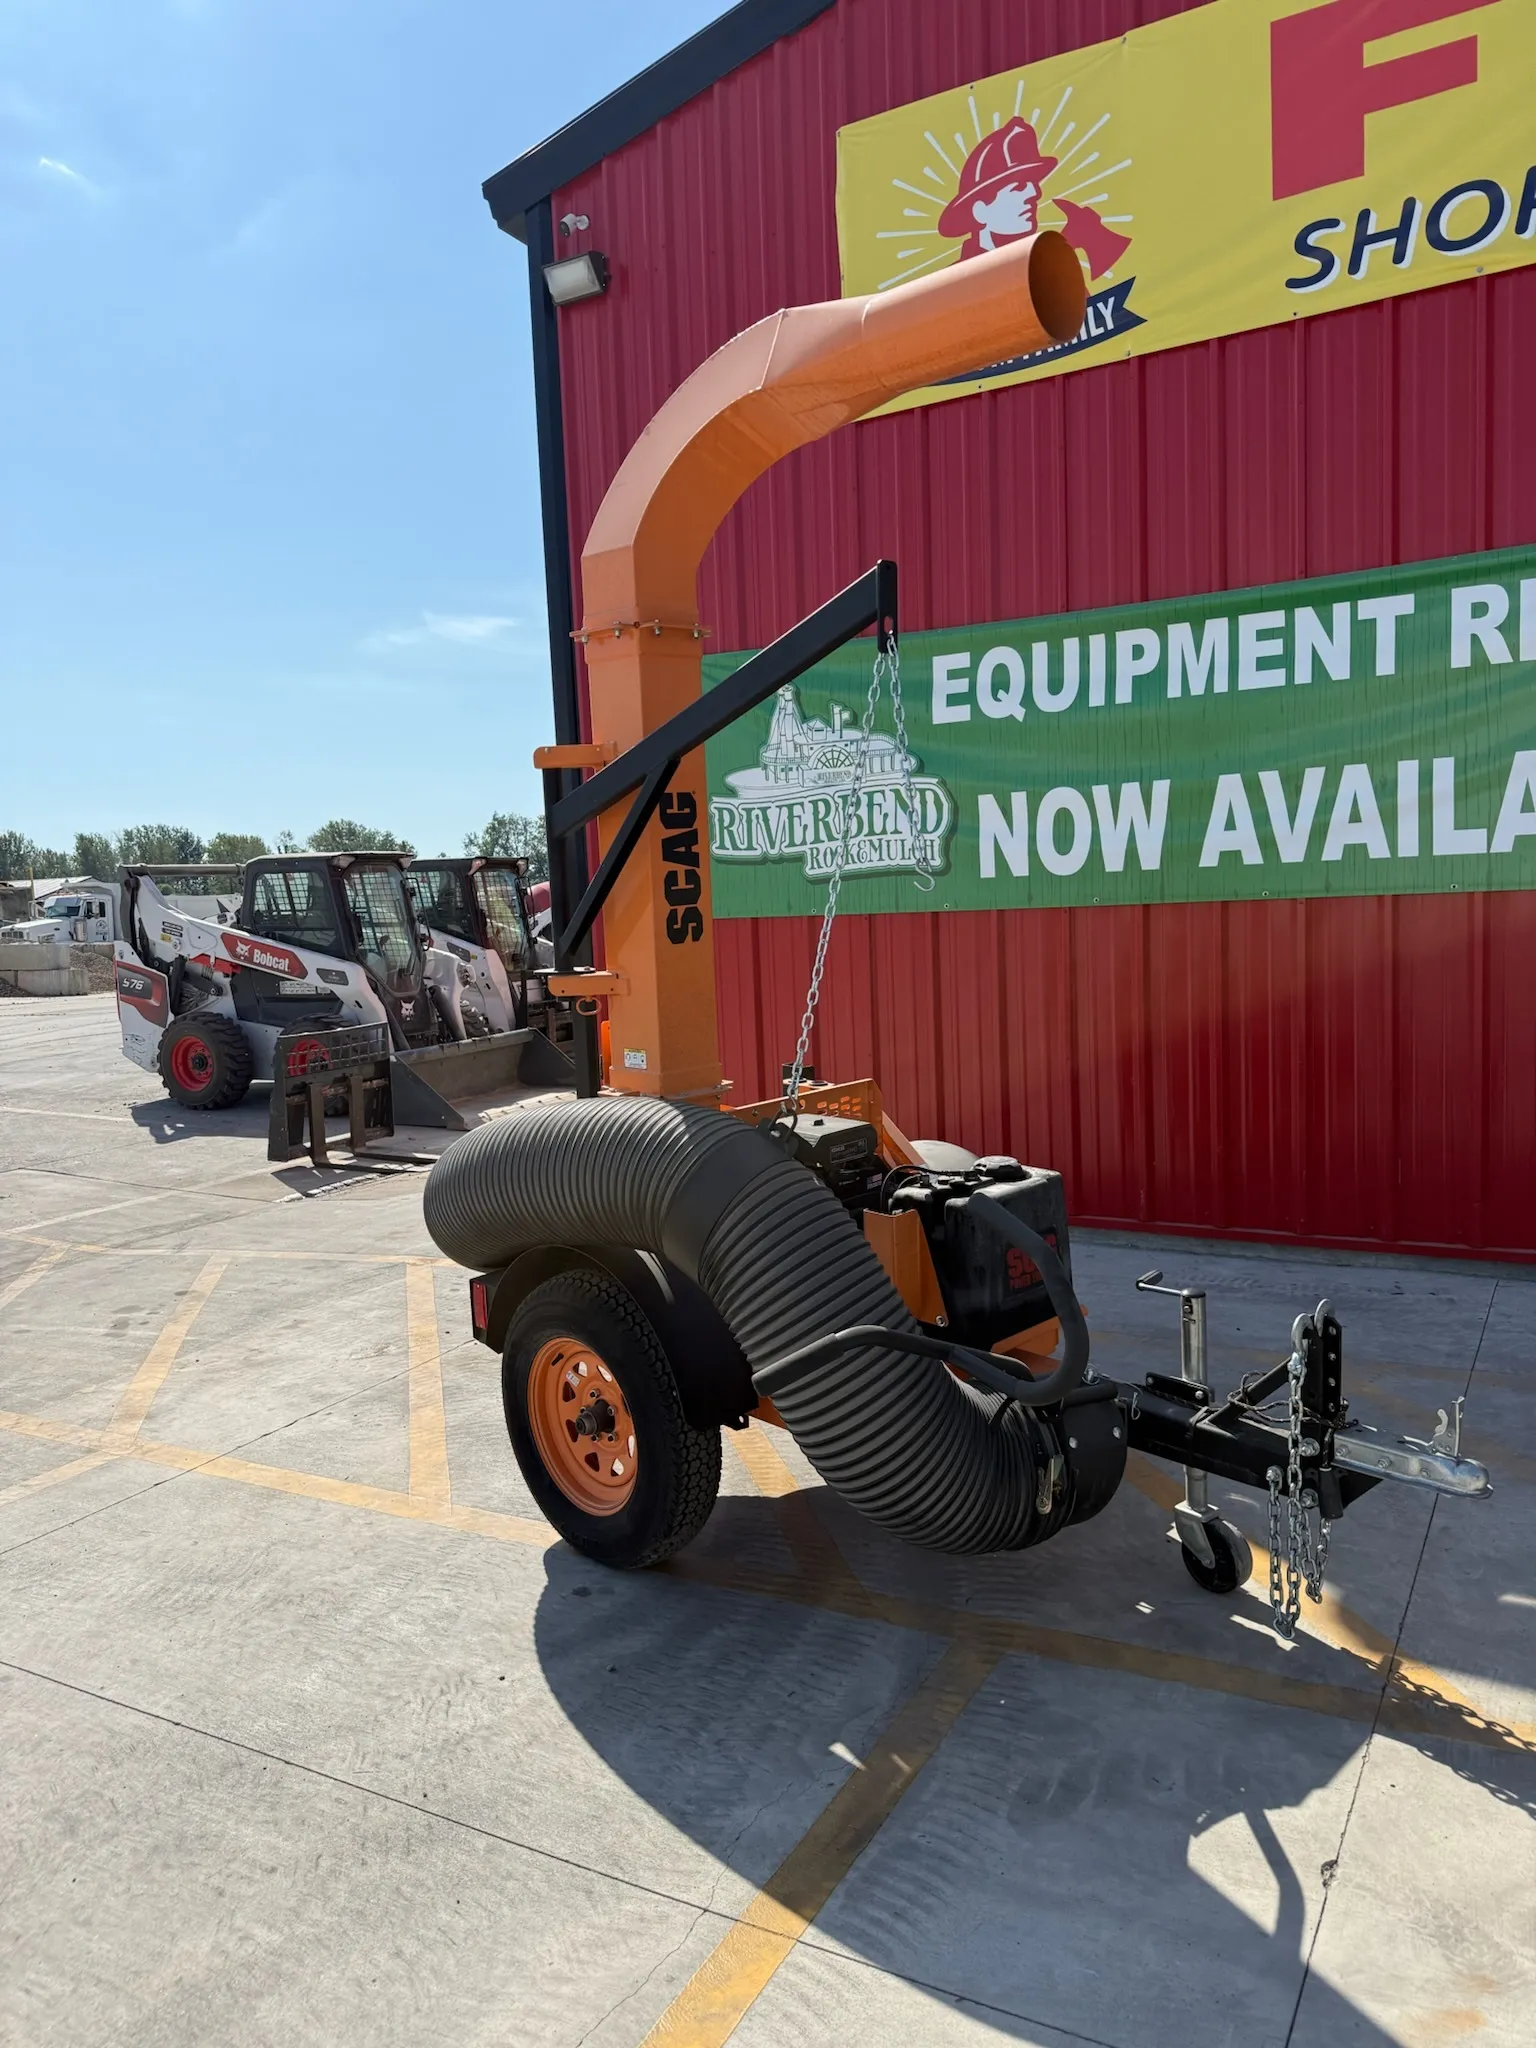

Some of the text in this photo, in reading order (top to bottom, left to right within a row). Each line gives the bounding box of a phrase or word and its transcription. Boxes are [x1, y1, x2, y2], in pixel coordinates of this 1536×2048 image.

[932, 592, 1415, 725] EQUIPMENT
[713, 787, 945, 852] RIVERBEND
[977, 750, 1536, 878] NOW AVAILA
[659, 791, 704, 945] SCAG
[122, 977, 145, 991] S76
[252, 948, 290, 973] Bobcat
